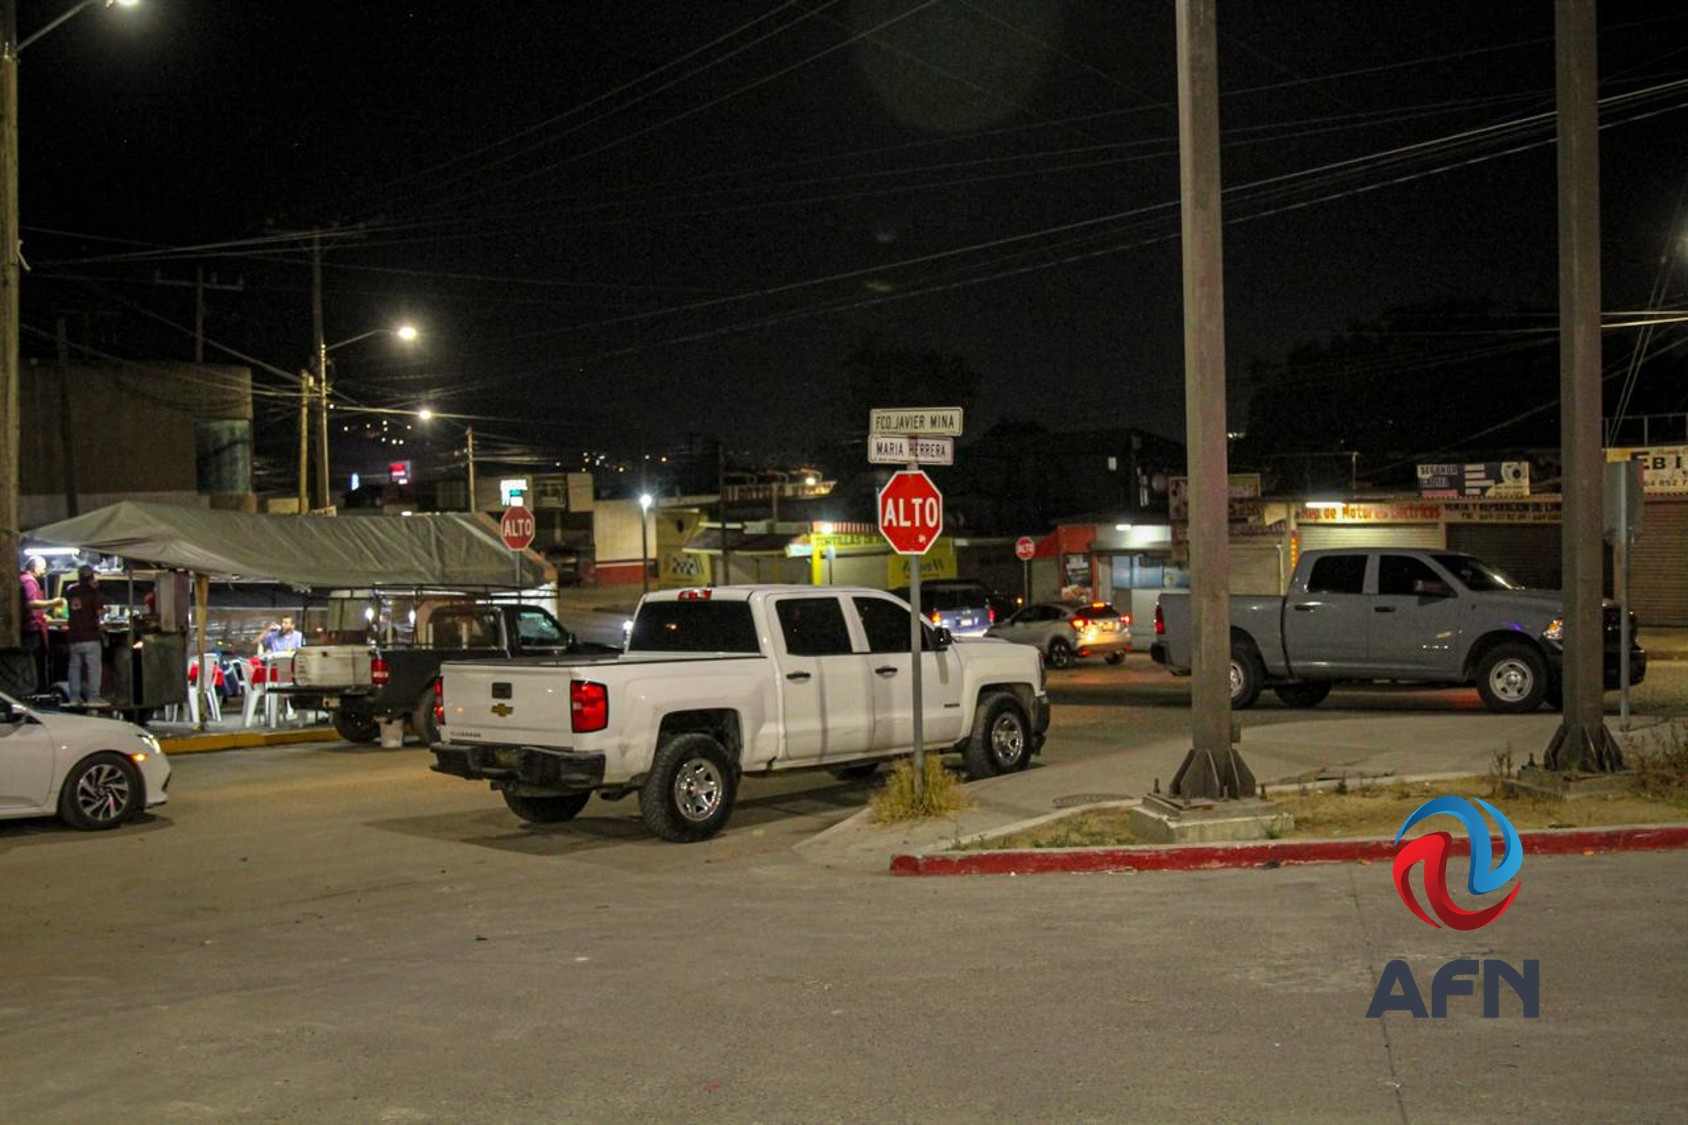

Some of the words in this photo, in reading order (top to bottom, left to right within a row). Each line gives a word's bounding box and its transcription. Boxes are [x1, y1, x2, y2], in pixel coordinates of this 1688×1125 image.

[930, 415, 954, 429] MINA
[876, 442, 903, 456] MARIA
[908, 443, 947, 457] HERRERA
[883, 497, 939, 528] ALTO
[504, 519, 532, 537] ALTO
